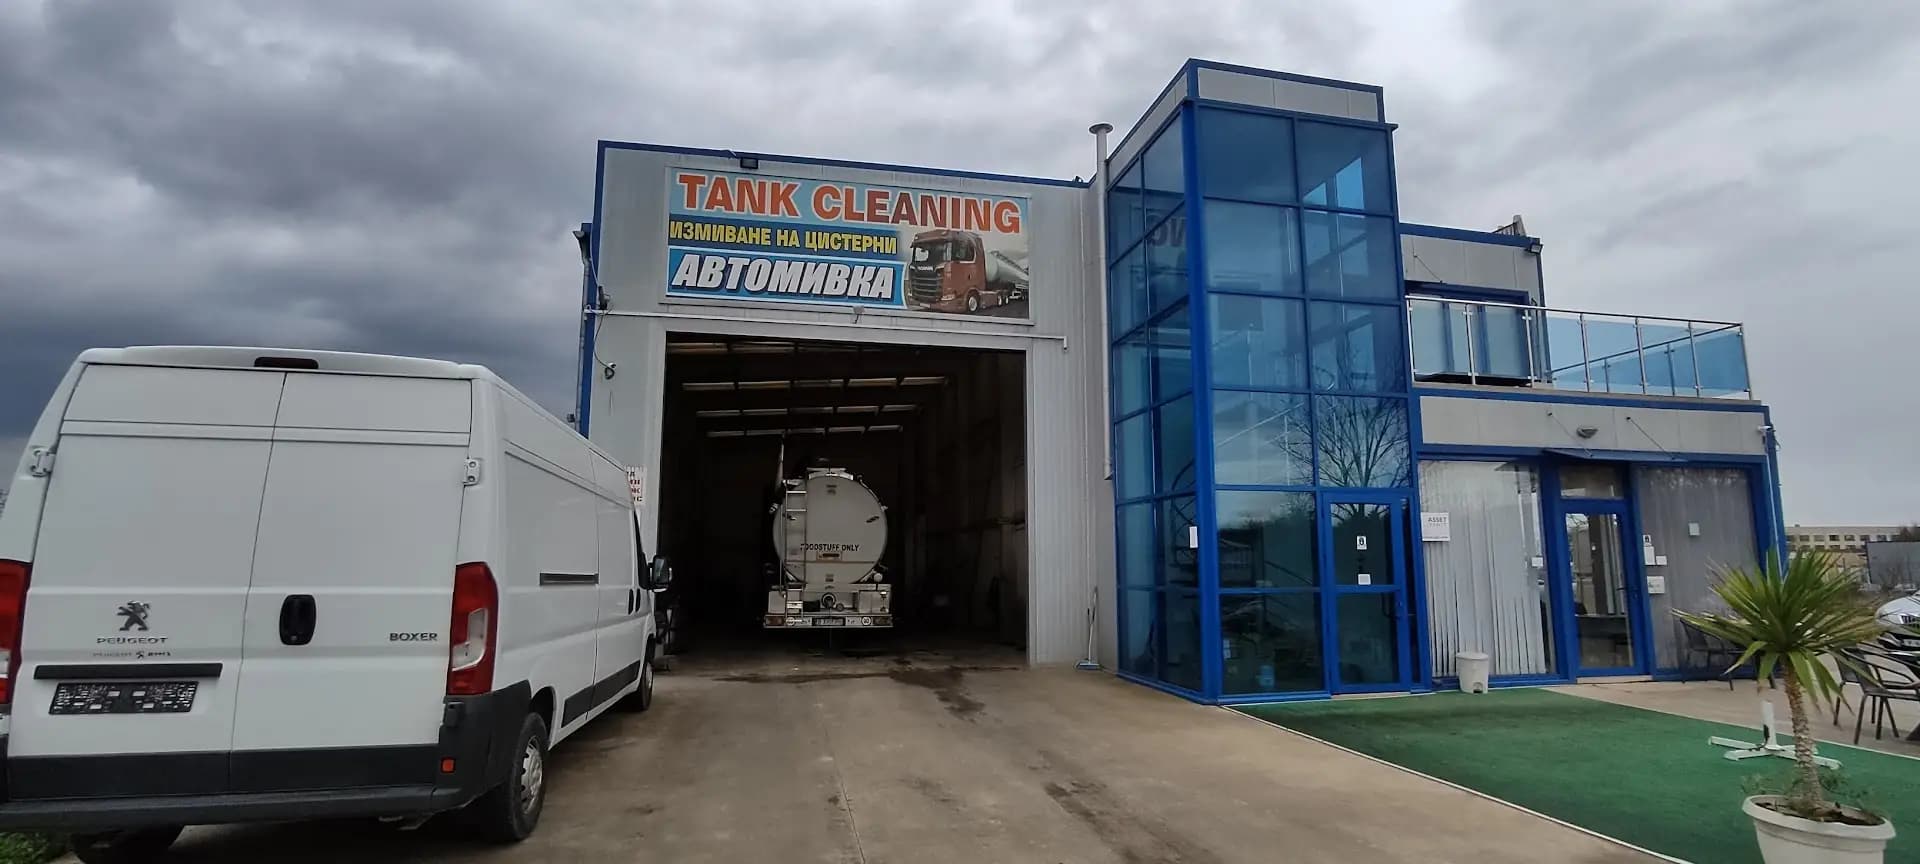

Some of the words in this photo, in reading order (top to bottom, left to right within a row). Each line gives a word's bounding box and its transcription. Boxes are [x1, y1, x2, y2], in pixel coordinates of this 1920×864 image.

[678, 174, 800, 217] TANK
[812, 185, 1021, 234] CLEANING
[669, 221, 772, 246] ИЗМИВАНЕ
[776, 229, 801, 248] НА
[805, 230, 898, 255] ЦИСТЕРНИ
[671, 253, 895, 300] АВТОМИВКА
[841, 544, 860, 552] ONLY
[96, 637, 168, 645] PEUGEOT
[389, 632, 438, 642] BOXER
